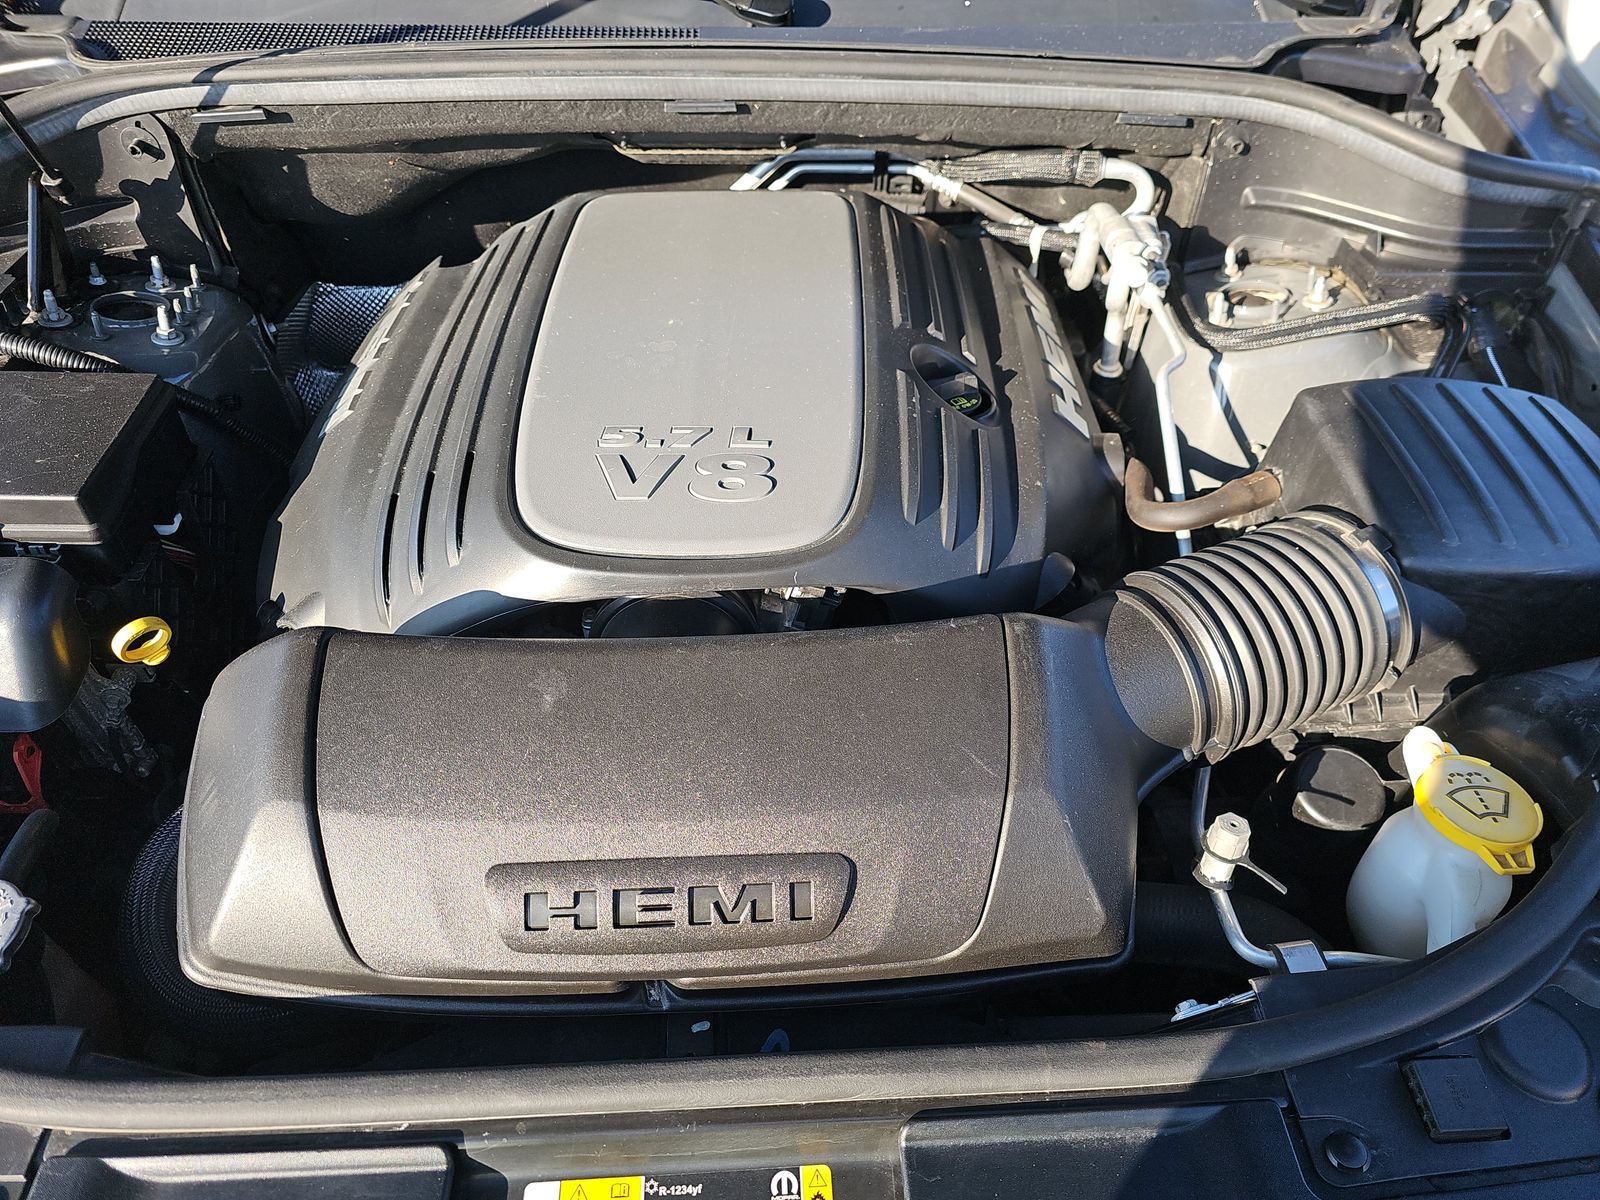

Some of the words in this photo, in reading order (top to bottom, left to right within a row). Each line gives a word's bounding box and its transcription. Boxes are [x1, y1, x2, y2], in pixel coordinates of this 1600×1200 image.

[1013, 267, 1091, 440] HEMI
[597, 426, 714, 448] 5.7
[728, 426, 772, 448] L
[595, 453, 778, 503] V8
[524, 881, 814, 932] HEMI
[658, 1184, 703, 1197] R-1234yf
